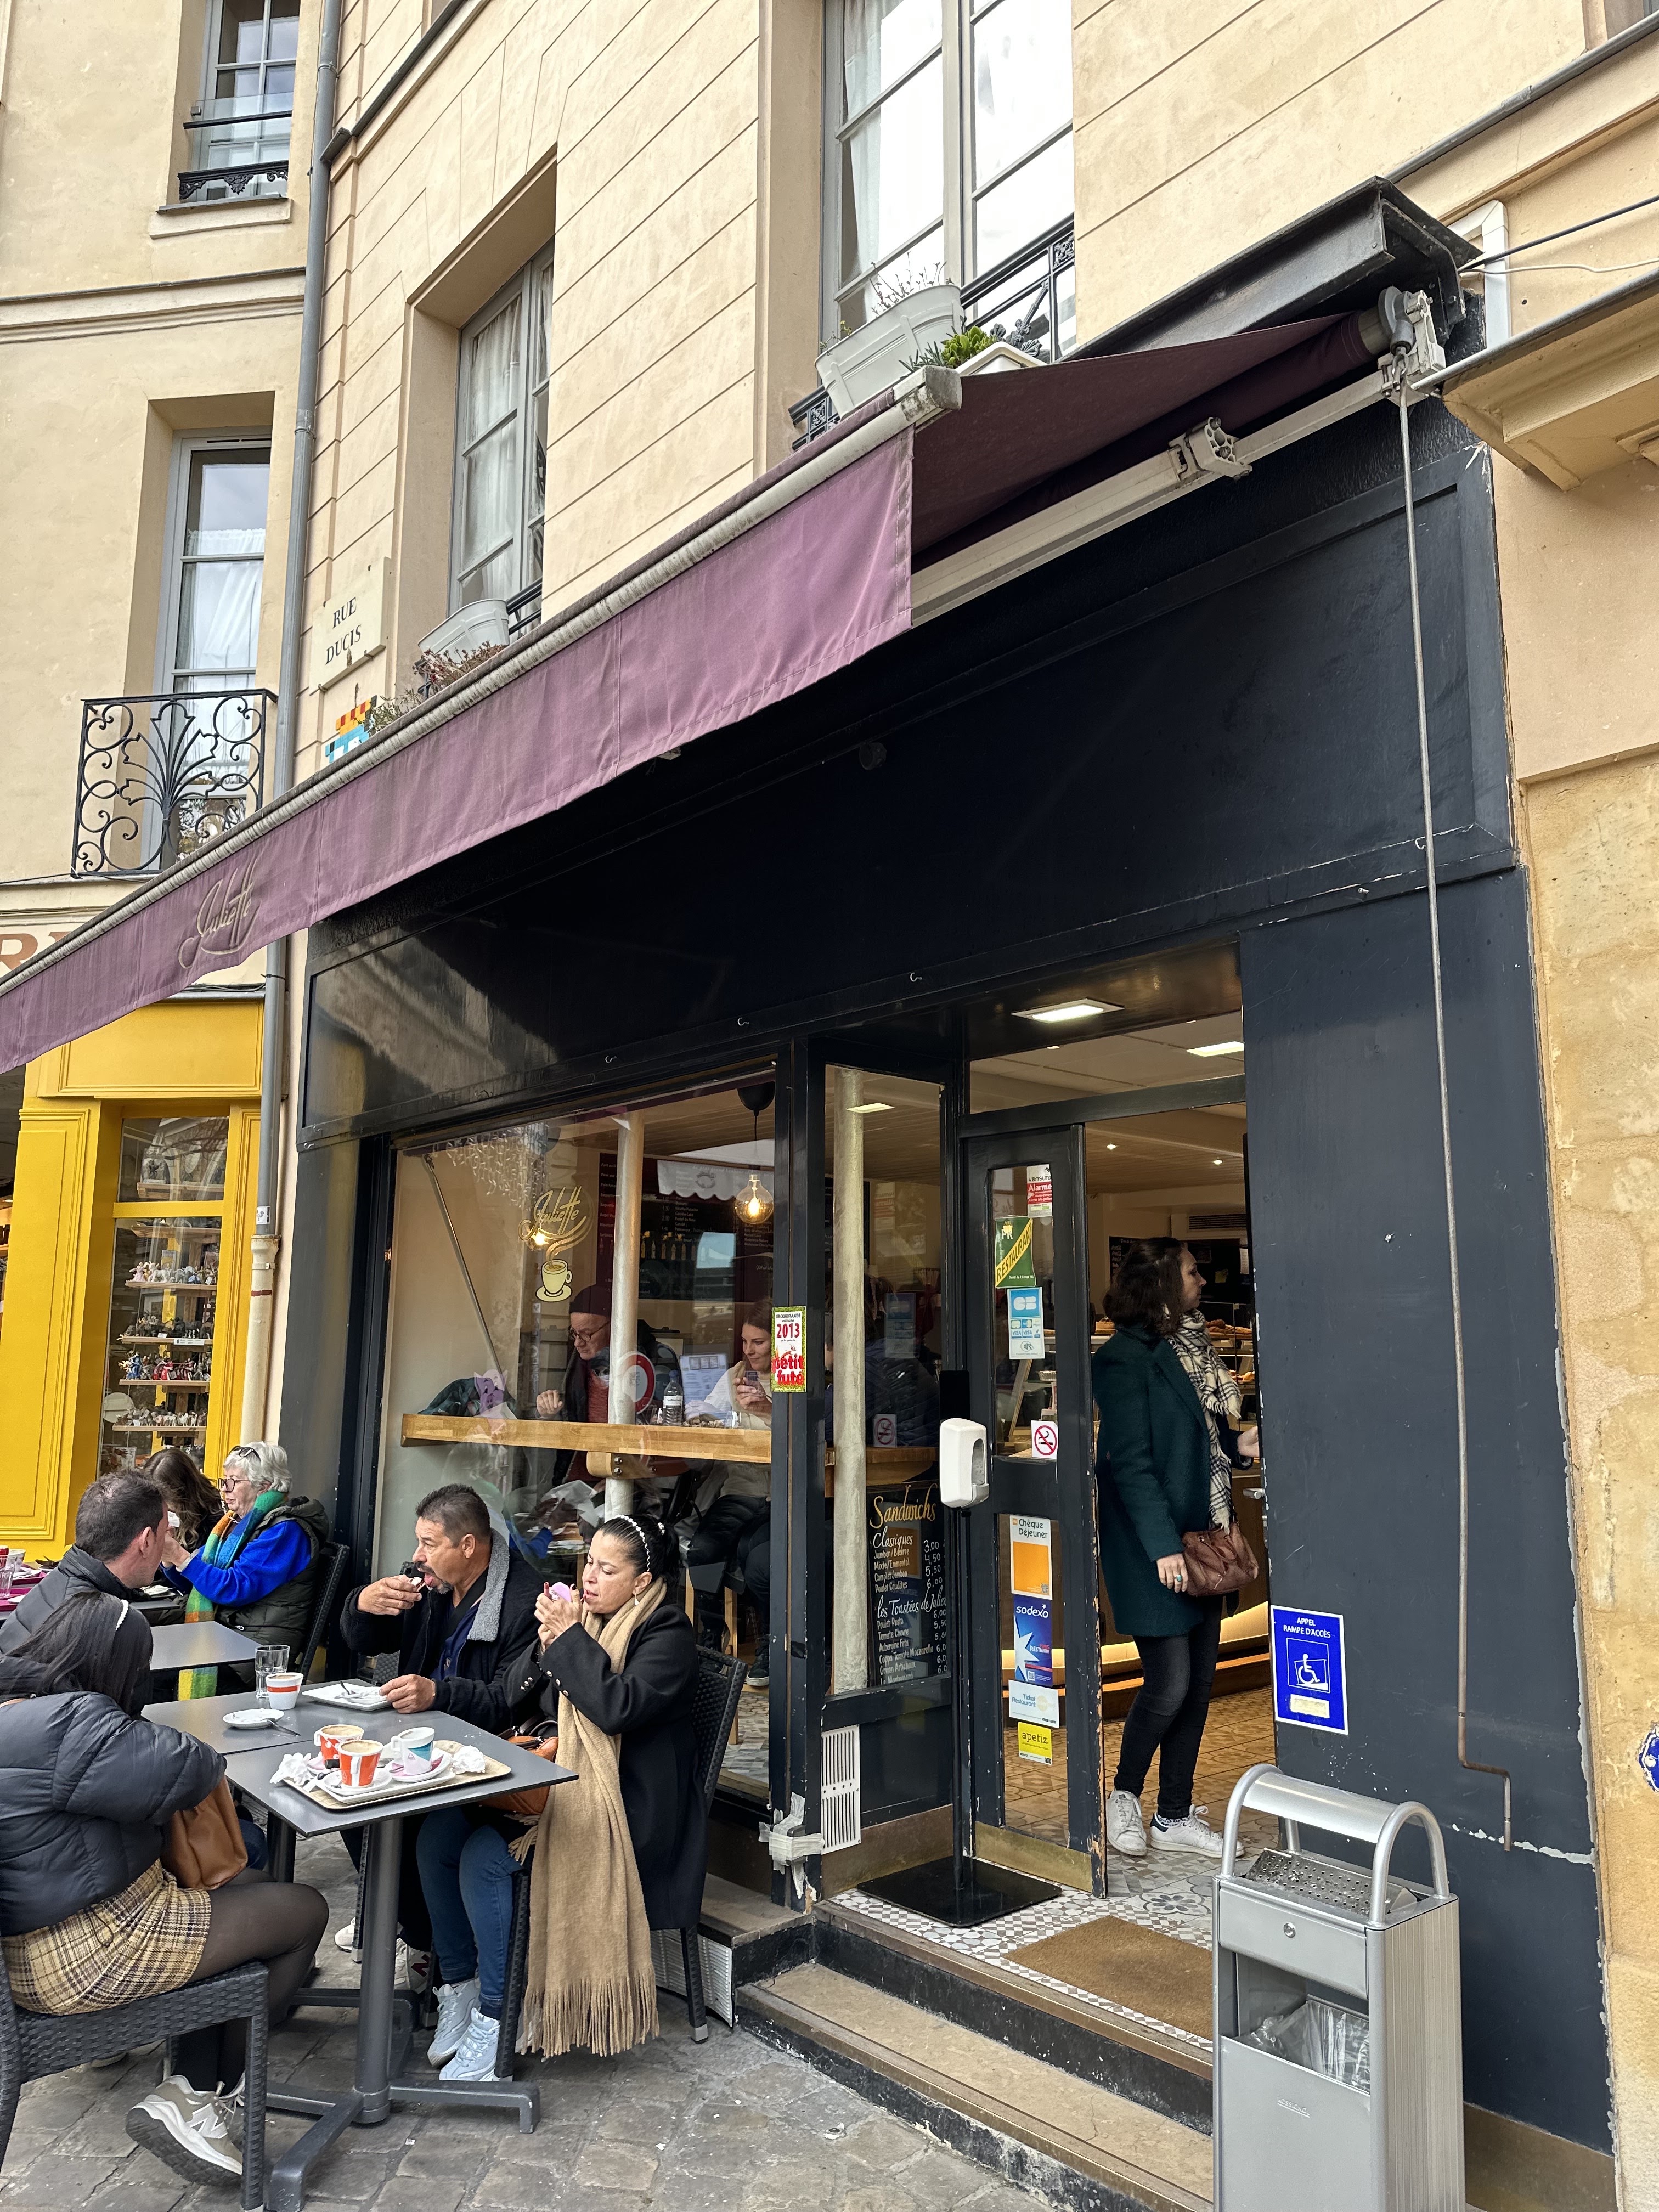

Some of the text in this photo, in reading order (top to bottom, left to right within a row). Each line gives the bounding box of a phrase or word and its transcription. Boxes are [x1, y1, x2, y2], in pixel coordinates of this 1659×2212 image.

[332, 596, 357, 629] RUE
[325, 624, 362, 665] DUCIS
[178, 859, 261, 969] Juliette
[1028, 1183, 1052, 1192] Alarme
[518, 1186, 586, 1240] Juliette
[997, 1222, 1032, 1283] RESTAURANT
[1013, 1296, 1037, 1311] CB
[776, 1323, 800, 1338] 2013
[771, 1353, 805, 1374] petit
[777, 1369, 804, 1386] futé
[870, 1482, 938, 1529] Sandwichs
[1019, 1519, 1043, 1529] Chèque
[873, 1526, 913, 1553] Classiques
[1019, 1527, 1048, 1538] Déjeuner
[923, 1539, 940, 1553] 3,00
[924, 1553, 941, 1565] 4,50
[874, 1570, 891, 1583] Complet
[925, 1565, 941, 1577] 5,50
[875, 1583, 889, 1594] Poulet
[888, 1598, 919, 1616] Toastées
[921, 1587, 930, 1610] de
[1015, 1606, 1049, 1618] sodexo
[877, 1618, 890, 1630] Poulet
[891, 1617, 904, 1627] Pesto
[1296, 1617, 1316, 1627] APPEL
[878, 1630, 894, 1641] Tomate
[1283, 1624, 1331, 1638] RAMPE D'ACCÈS
[879, 1640, 899, 1653] Aubergine
[900, 1638, 909, 1647] Feta
[879, 1654, 893, 1668] Coppa
[893, 1650, 910, 1661] Tomate
[910, 1644, 934, 1657] Mozzarella
[1012, 1696, 1036, 1707] Restaurant
[1022, 1732, 1048, 1745] apetiz
